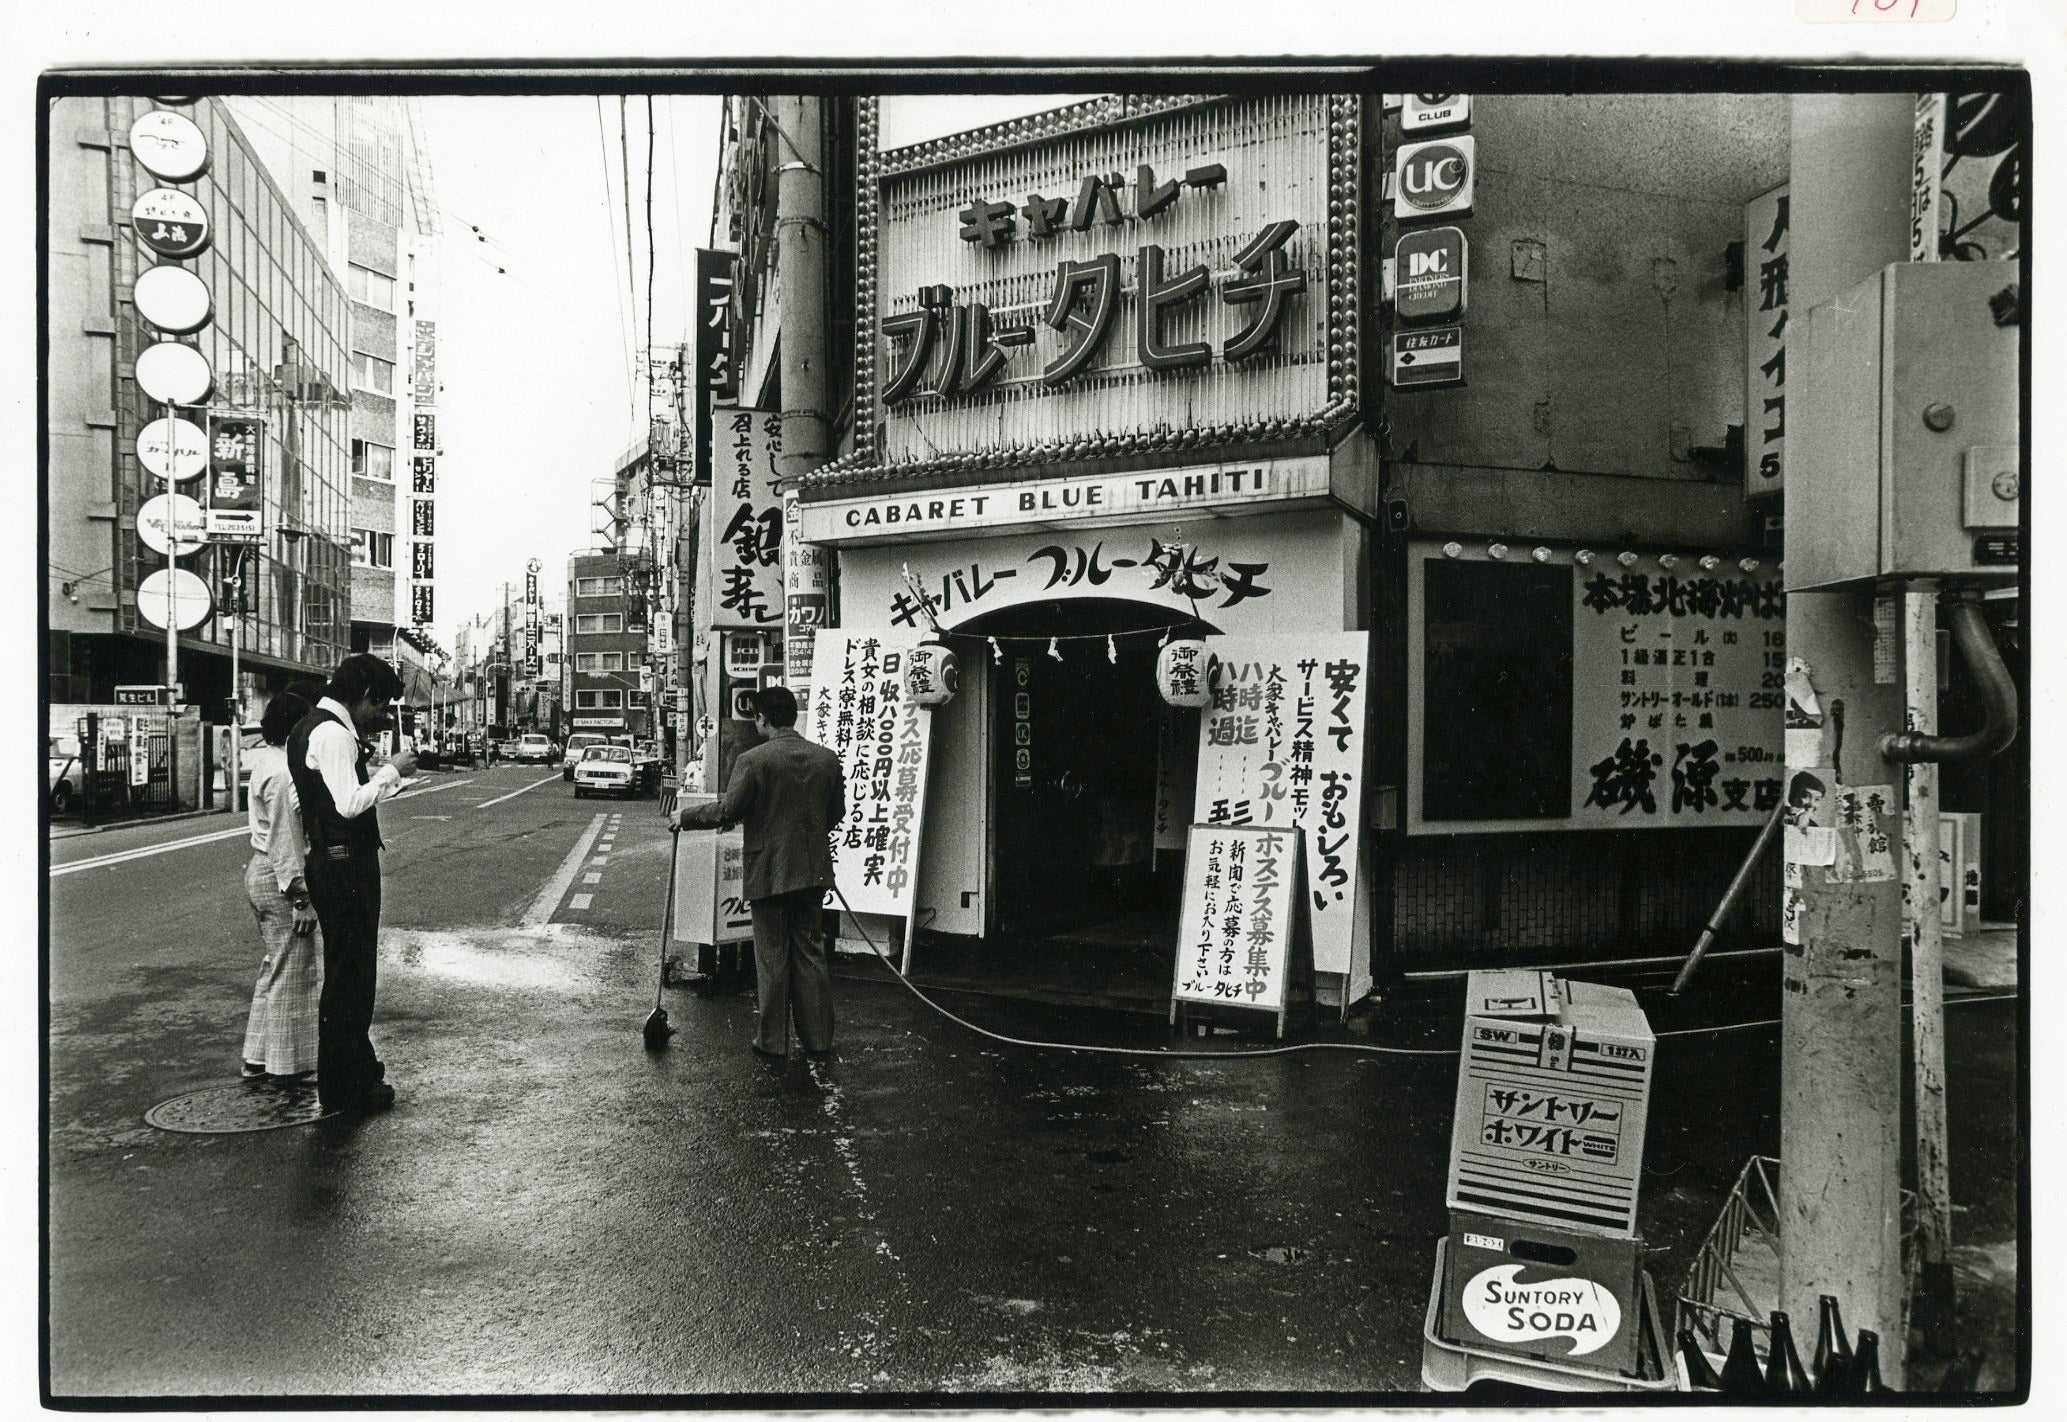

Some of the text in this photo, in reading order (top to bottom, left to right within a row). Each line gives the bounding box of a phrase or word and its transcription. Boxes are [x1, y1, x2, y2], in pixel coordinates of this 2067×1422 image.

[1418, 109, 1452, 122] CLUB
[1405, 157, 1465, 194] UC
[958, 162, 1227, 249] キャバレー
[151, 221, 188, 243] 上海
[1409, 248, 1448, 277] DC
[881, 218, 1307, 406] ブルータヒチ
[1406, 332, 1453, 349] 住友カード
[845, 468, 1264, 528] CABARET BLUE TAHITI
[889, 563, 1017, 629] キャバレー
[789, 606, 825, 625] カワノ
[732, 647, 759, 655] JCB
[908, 650, 935, 696] 御祭禮
[1169, 646, 1199, 697] 御祭禮
[1263, 663, 1288, 762] 大衆キャバレー
[843, 637, 881, 850] 貴女の相談に応じる店
[1313, 657, 1362, 912] 安くて おもしろい
[1195, 839, 1224, 979] お気軽にお入り下さい
[1217, 839, 1246, 976] 新聞で応募の方は
[1243, 831, 1284, 1003] ホステス募集中
[1181, 979, 1243, 998] ブルータヒチ
[1478, 1029, 1511, 1042] SW
[1489, 1089, 1619, 1122] サントリー
[1484, 1119, 1616, 1157] ホワイト WHITE
[1527, 1159, 1567, 1172] サントリー
[1507, 1306, 1598, 1333] SODA
